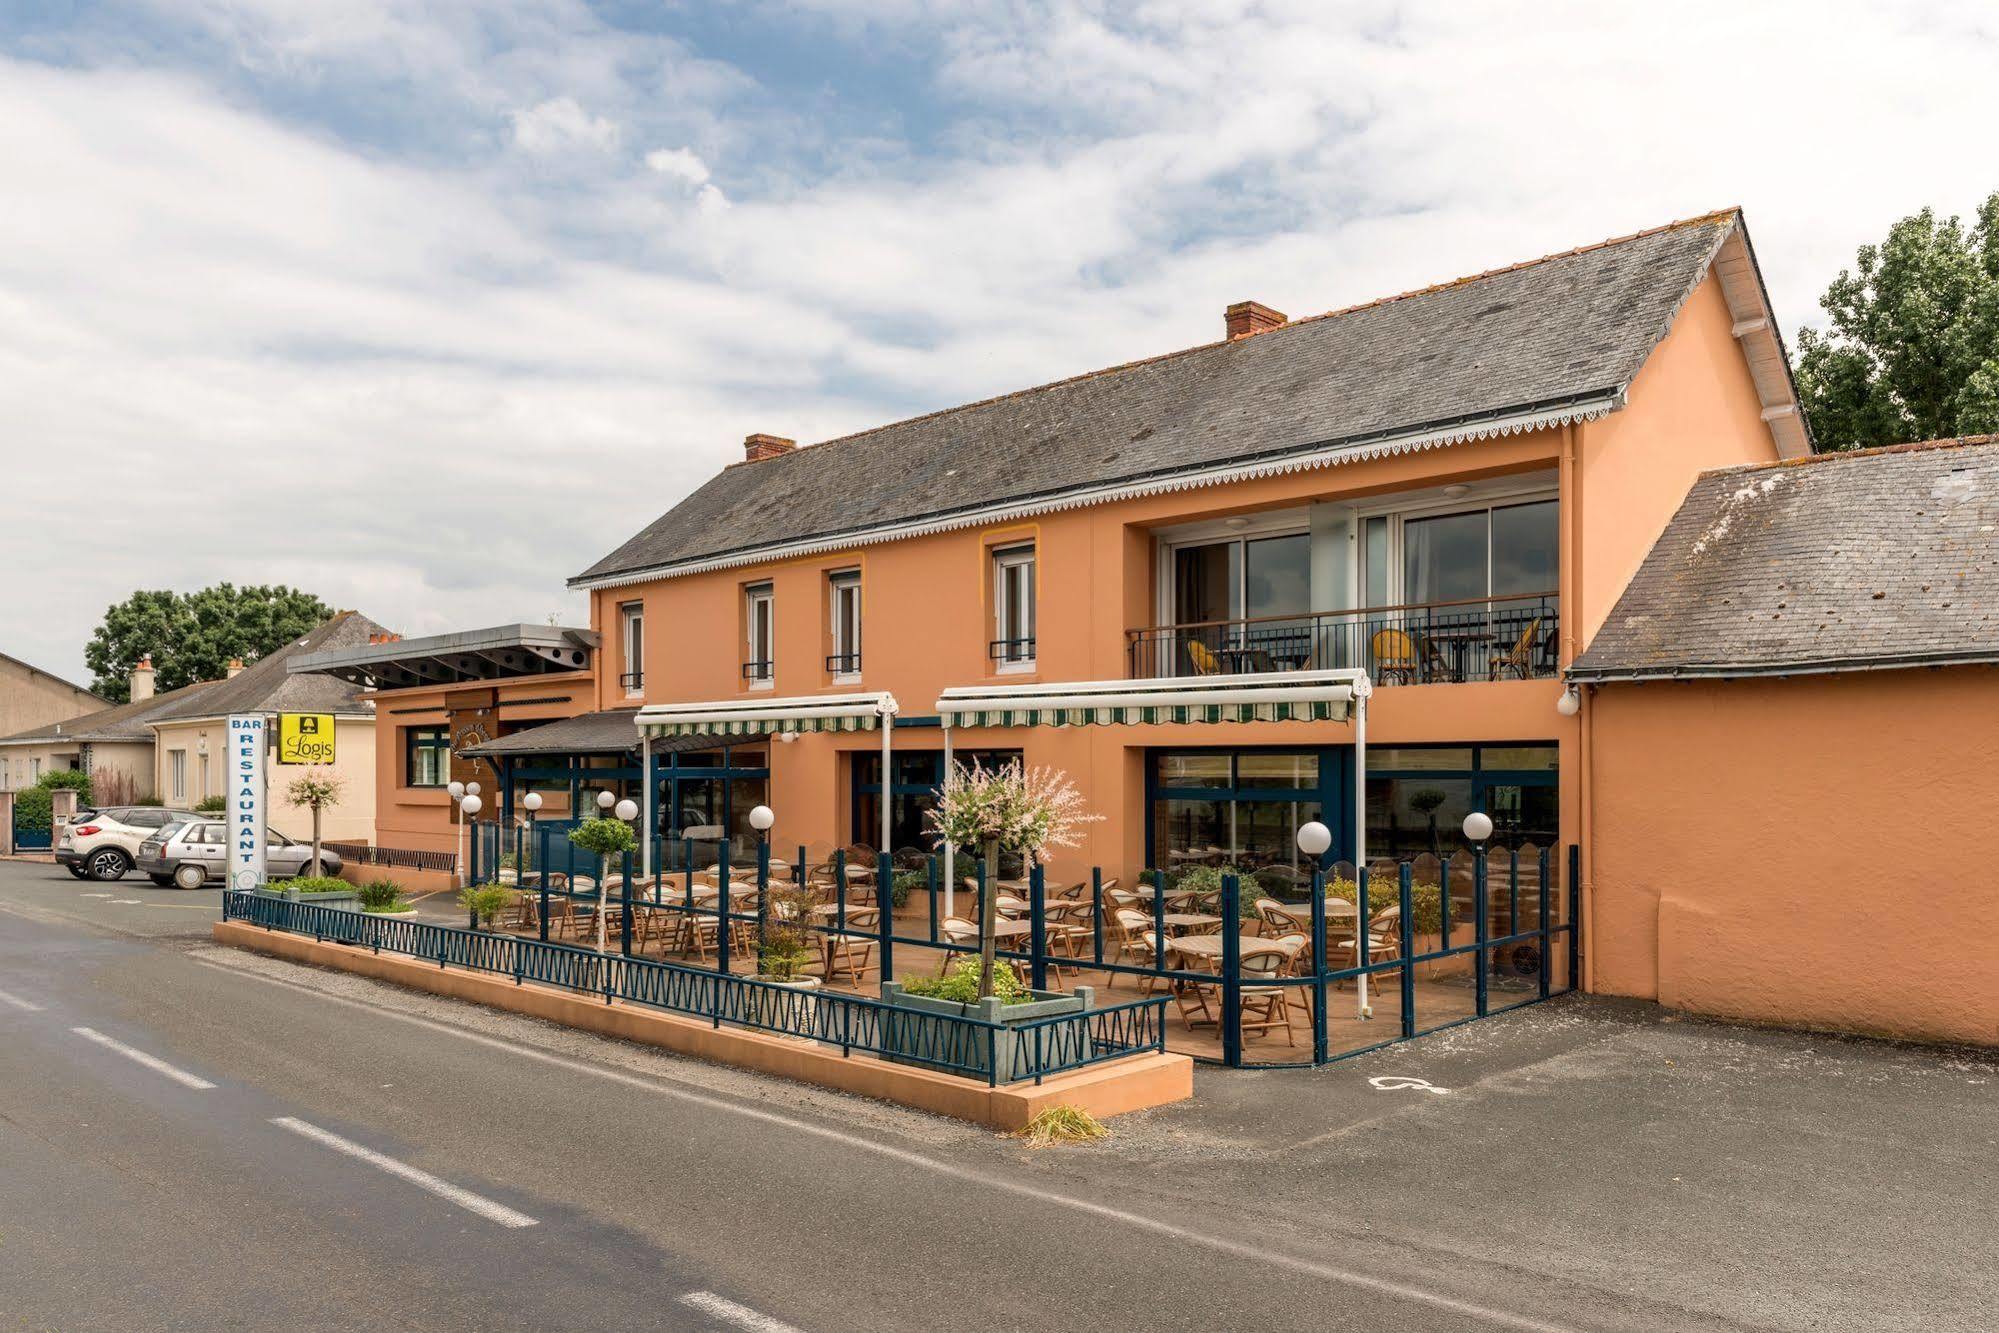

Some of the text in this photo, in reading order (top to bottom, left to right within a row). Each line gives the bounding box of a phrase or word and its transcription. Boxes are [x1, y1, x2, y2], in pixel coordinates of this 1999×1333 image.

[232, 720, 261, 729] BAR
[285, 735, 332, 760] Logis
[239, 735, 254, 862] RESTAURANT
